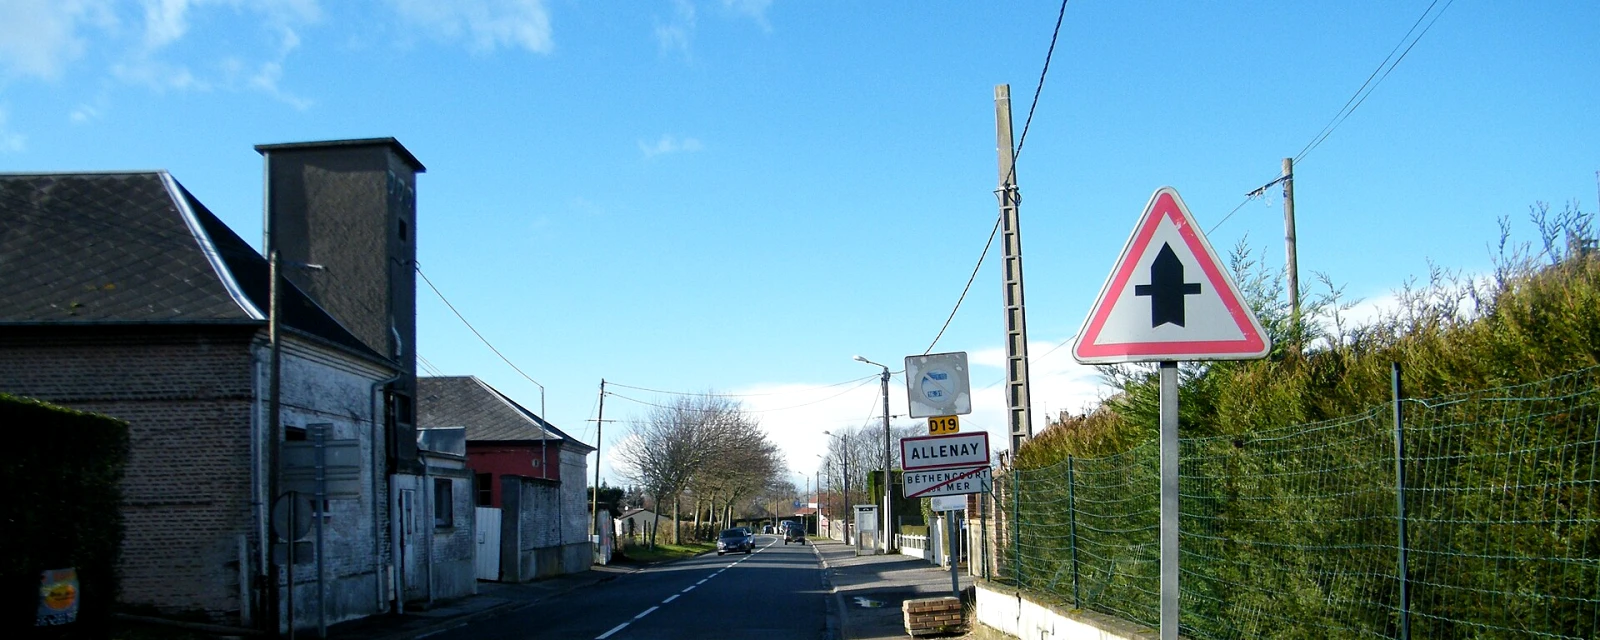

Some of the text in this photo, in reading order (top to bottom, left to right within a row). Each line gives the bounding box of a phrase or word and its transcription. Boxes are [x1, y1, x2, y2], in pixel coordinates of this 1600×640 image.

[929, 419, 957, 432] D19
[911, 442, 979, 460] ALLENAY
[907, 470, 988, 484] BÉTHENCOURT
[946, 482, 970, 491] MER
